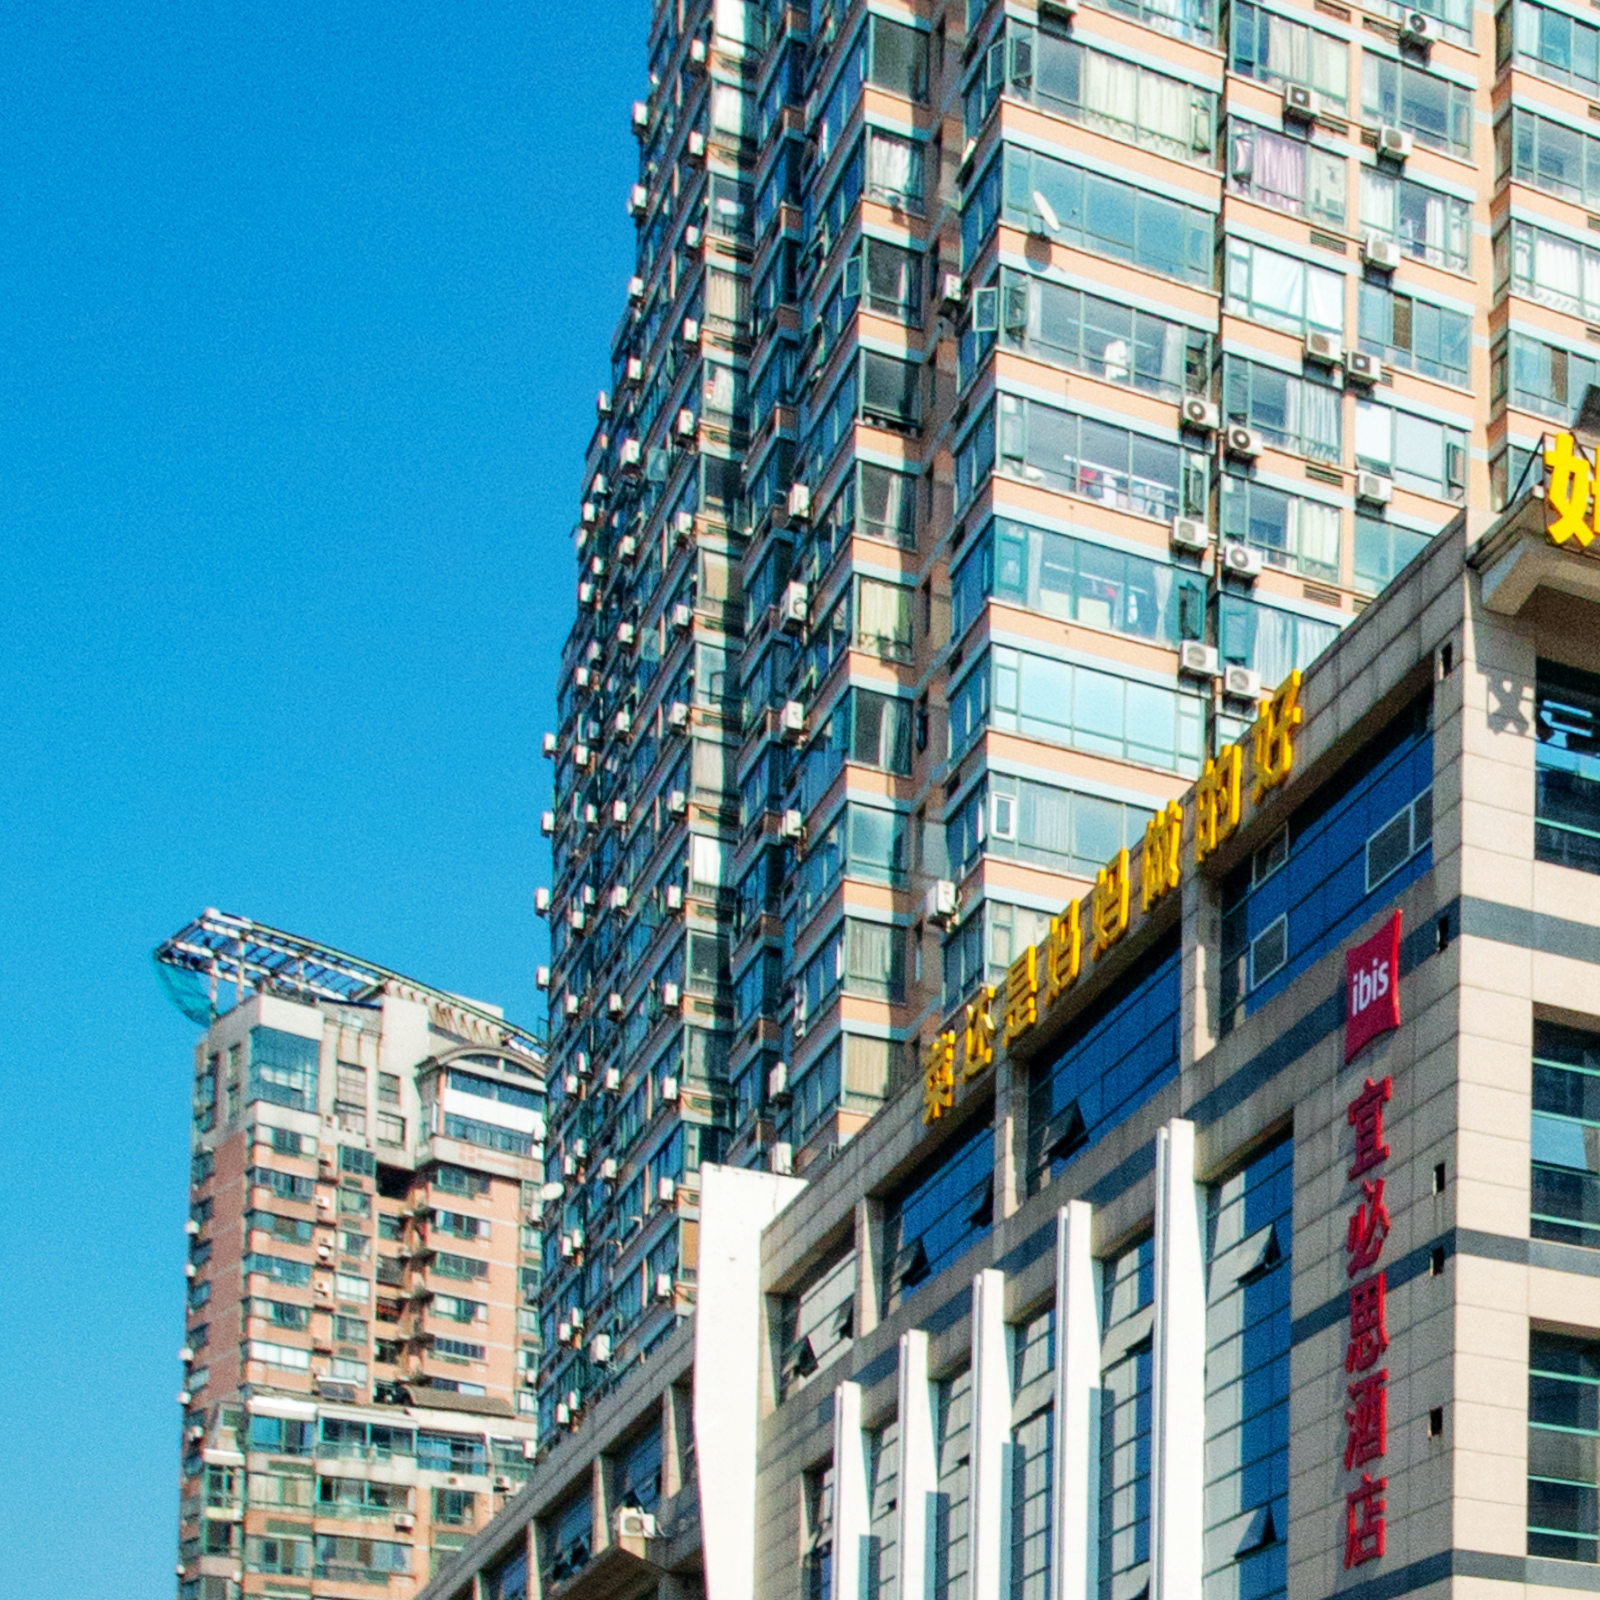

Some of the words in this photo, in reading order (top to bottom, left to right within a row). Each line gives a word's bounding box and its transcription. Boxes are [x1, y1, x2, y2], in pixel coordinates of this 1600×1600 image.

[1351, 958, 1390, 1017] ibis
[1344, 1077, 1391, 1570] 宜必思酒店
